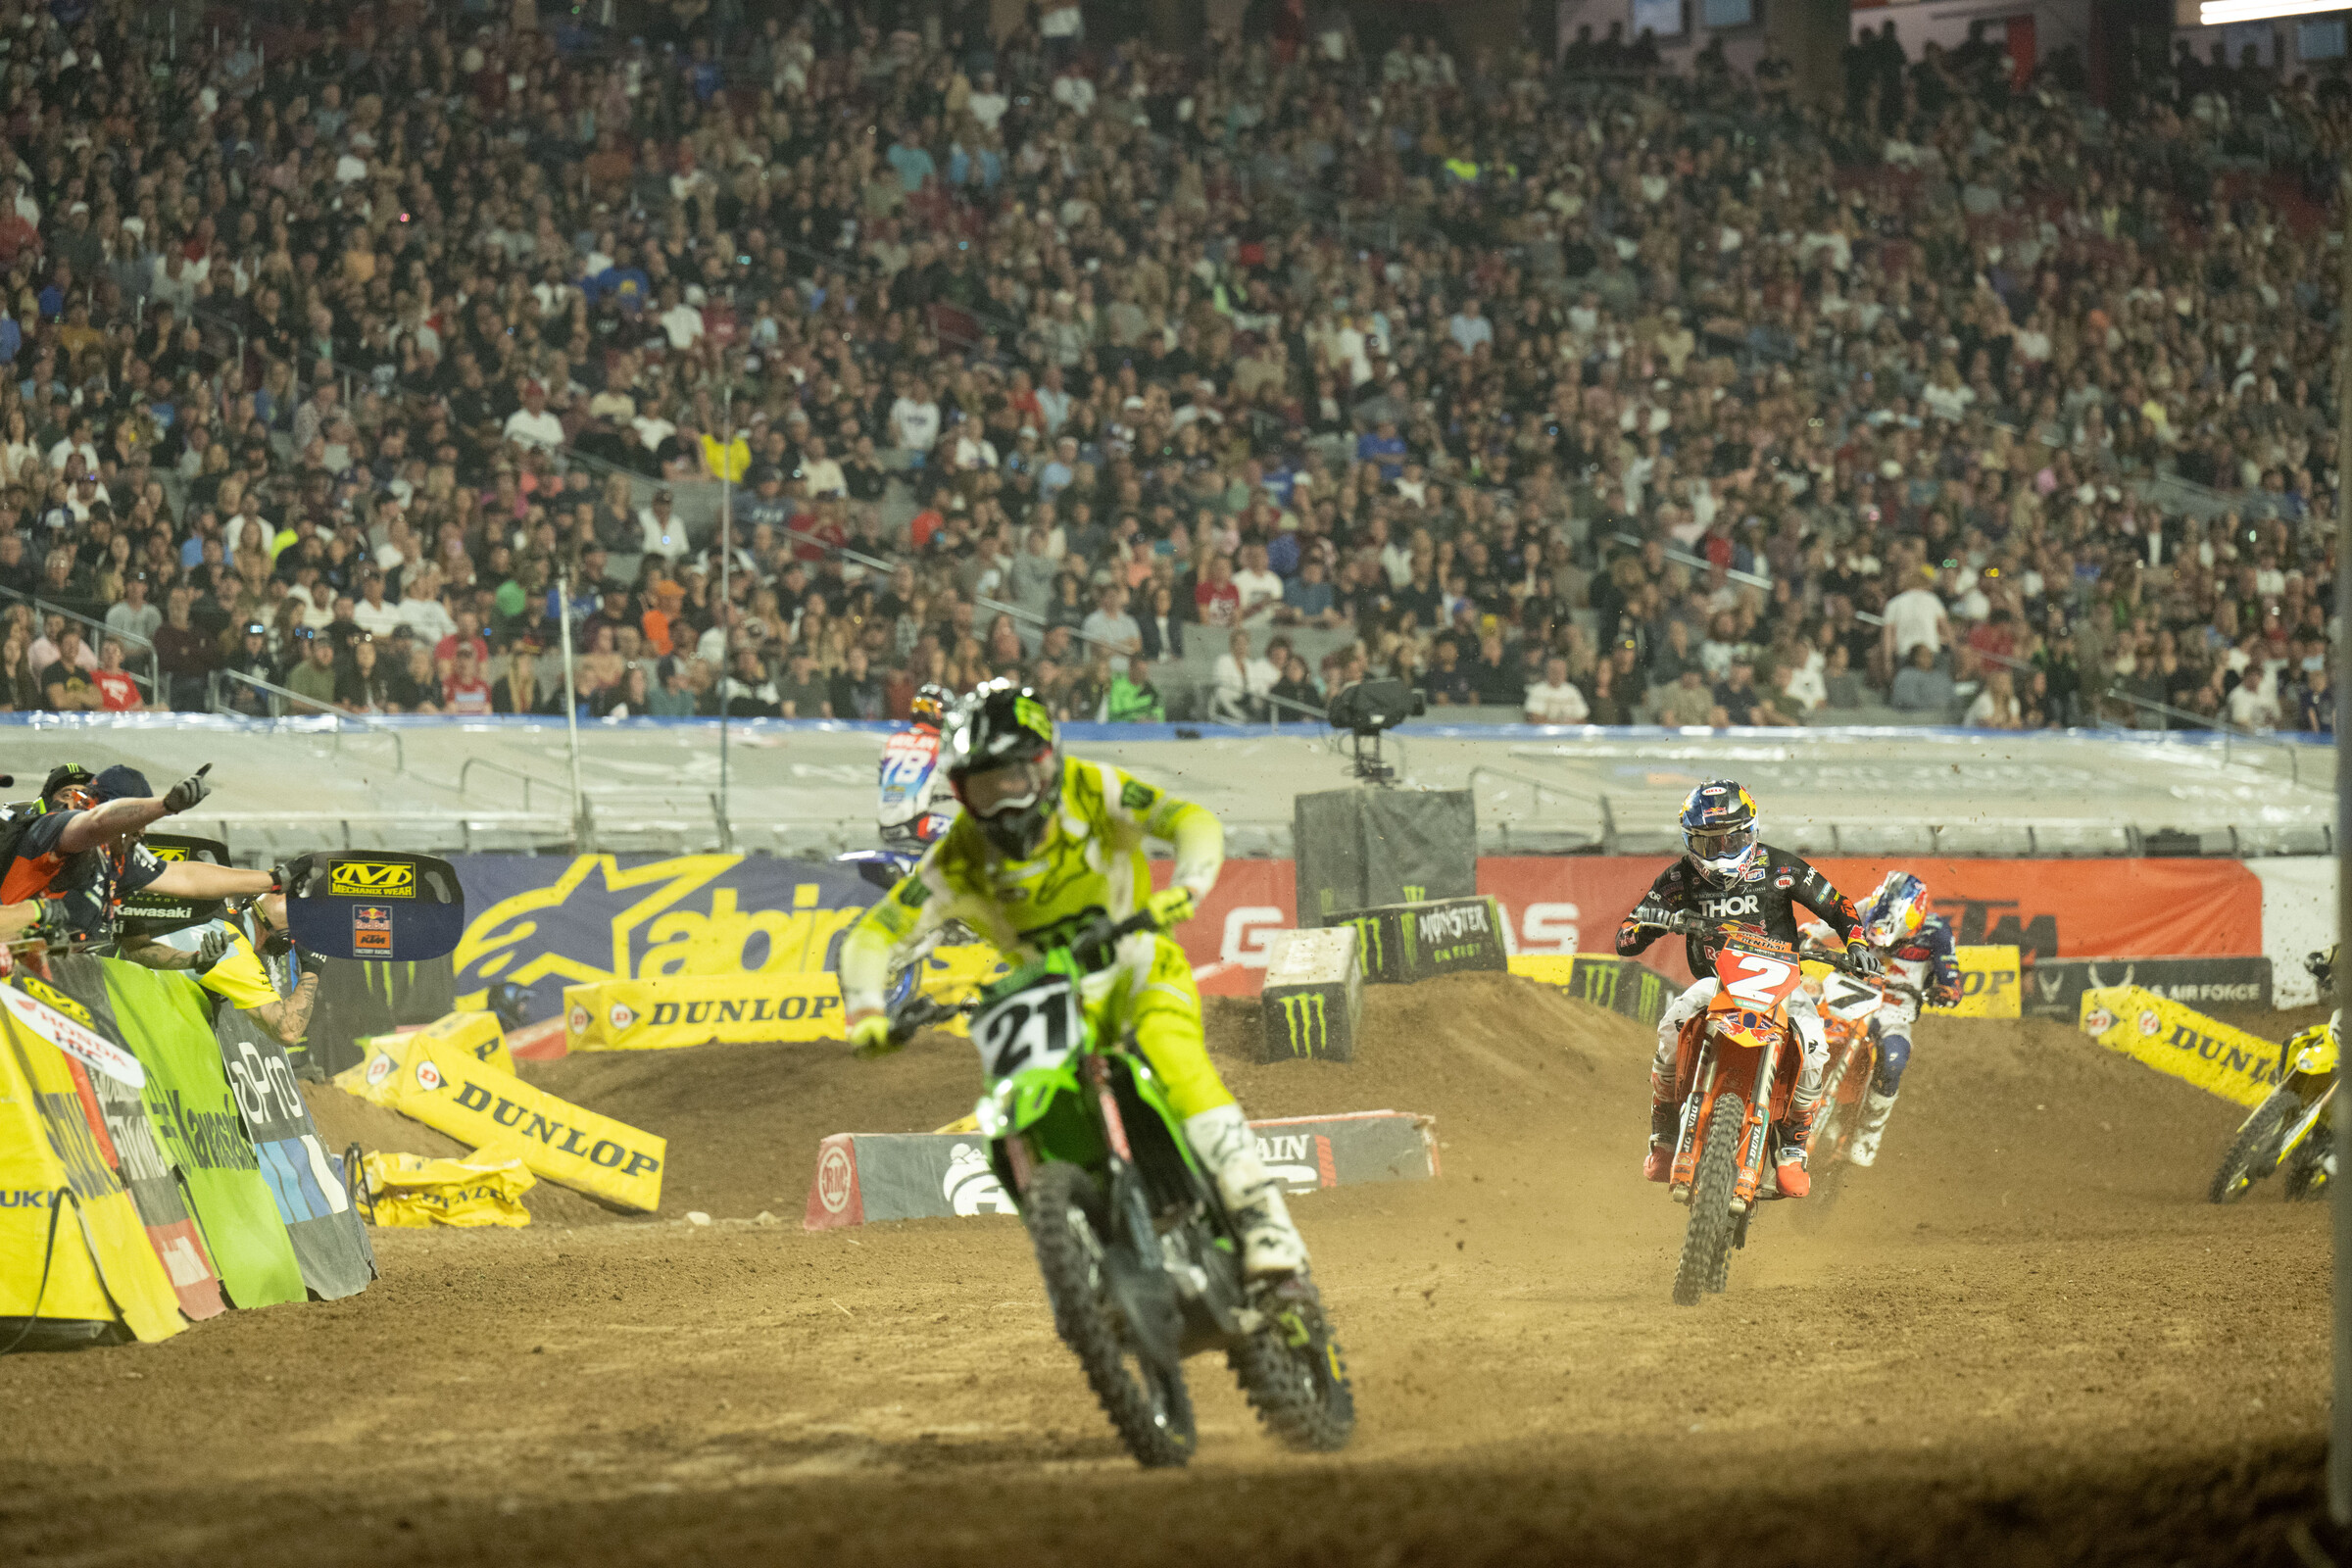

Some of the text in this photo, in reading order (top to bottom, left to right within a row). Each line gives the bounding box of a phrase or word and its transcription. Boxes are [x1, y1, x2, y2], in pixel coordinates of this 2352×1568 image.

[882, 750, 932, 784] 78
[331, 884, 413, 896] MECHANIX WEAR
[1746, 870, 1764, 881] 100%
[113, 905, 192, 918] Kawasaki
[1698, 895, 1759, 918] THOR
[1727, 956, 1792, 1004] 2
[1829, 980, 1879, 1010] 7
[649, 996, 840, 1026] DUNLOP
[987, 993, 1067, 1078] 21
[453, 1081, 660, 1178] DUNLOP
